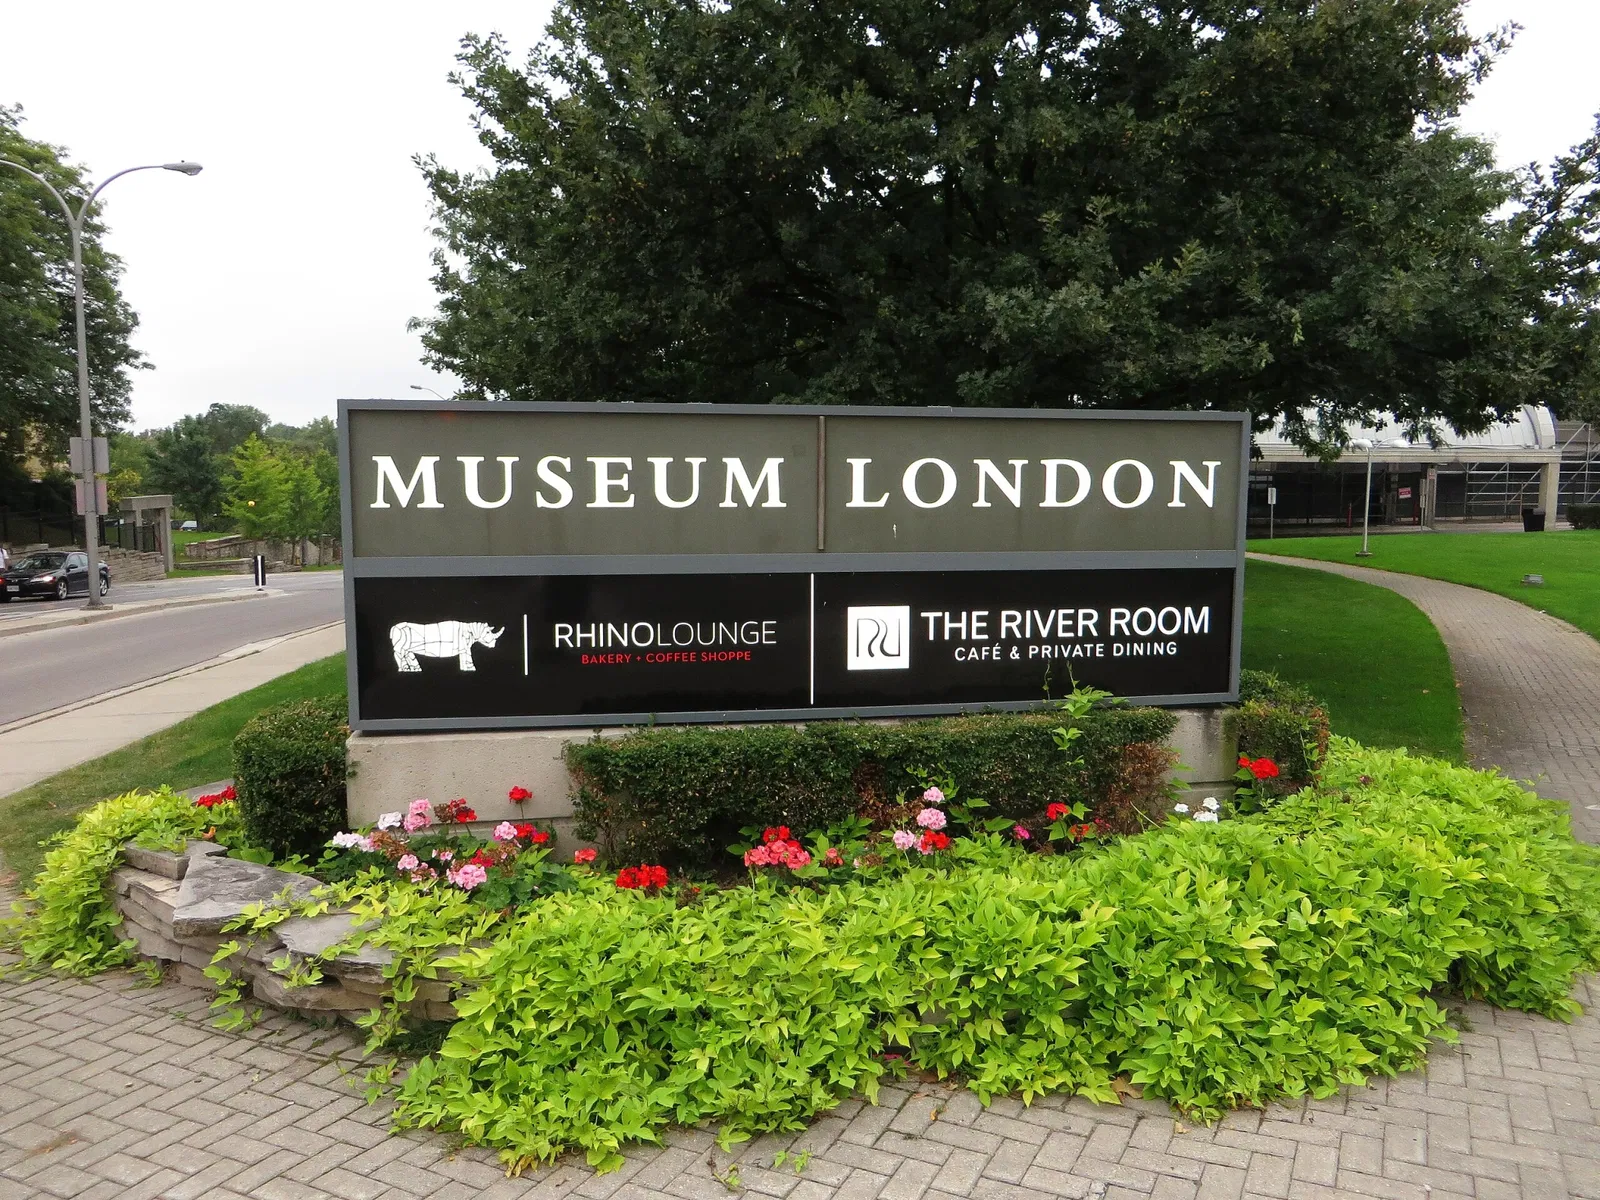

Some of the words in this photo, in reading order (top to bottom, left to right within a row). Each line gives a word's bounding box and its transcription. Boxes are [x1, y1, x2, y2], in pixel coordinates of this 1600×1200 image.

[369, 455, 787, 509] MUSEUM
[845, 457, 1222, 509] LONDON
[553, 620, 778, 649] RHINOLOUNGE
[920, 610, 989, 641] THE
[1000, 608, 1099, 639] RIVER
[1109, 605, 1210, 637] ROOM
[581, 653, 632, 665] BAKERY
[645, 652, 697, 663] COFFEE
[701, 650, 751, 662] SHOPPE
[954, 642, 1002, 662] CAFÉ
[1009, 645, 1021, 660] &
[1028, 643, 1105, 659] PRIVATE
[1112, 641, 1178, 657] DINING
